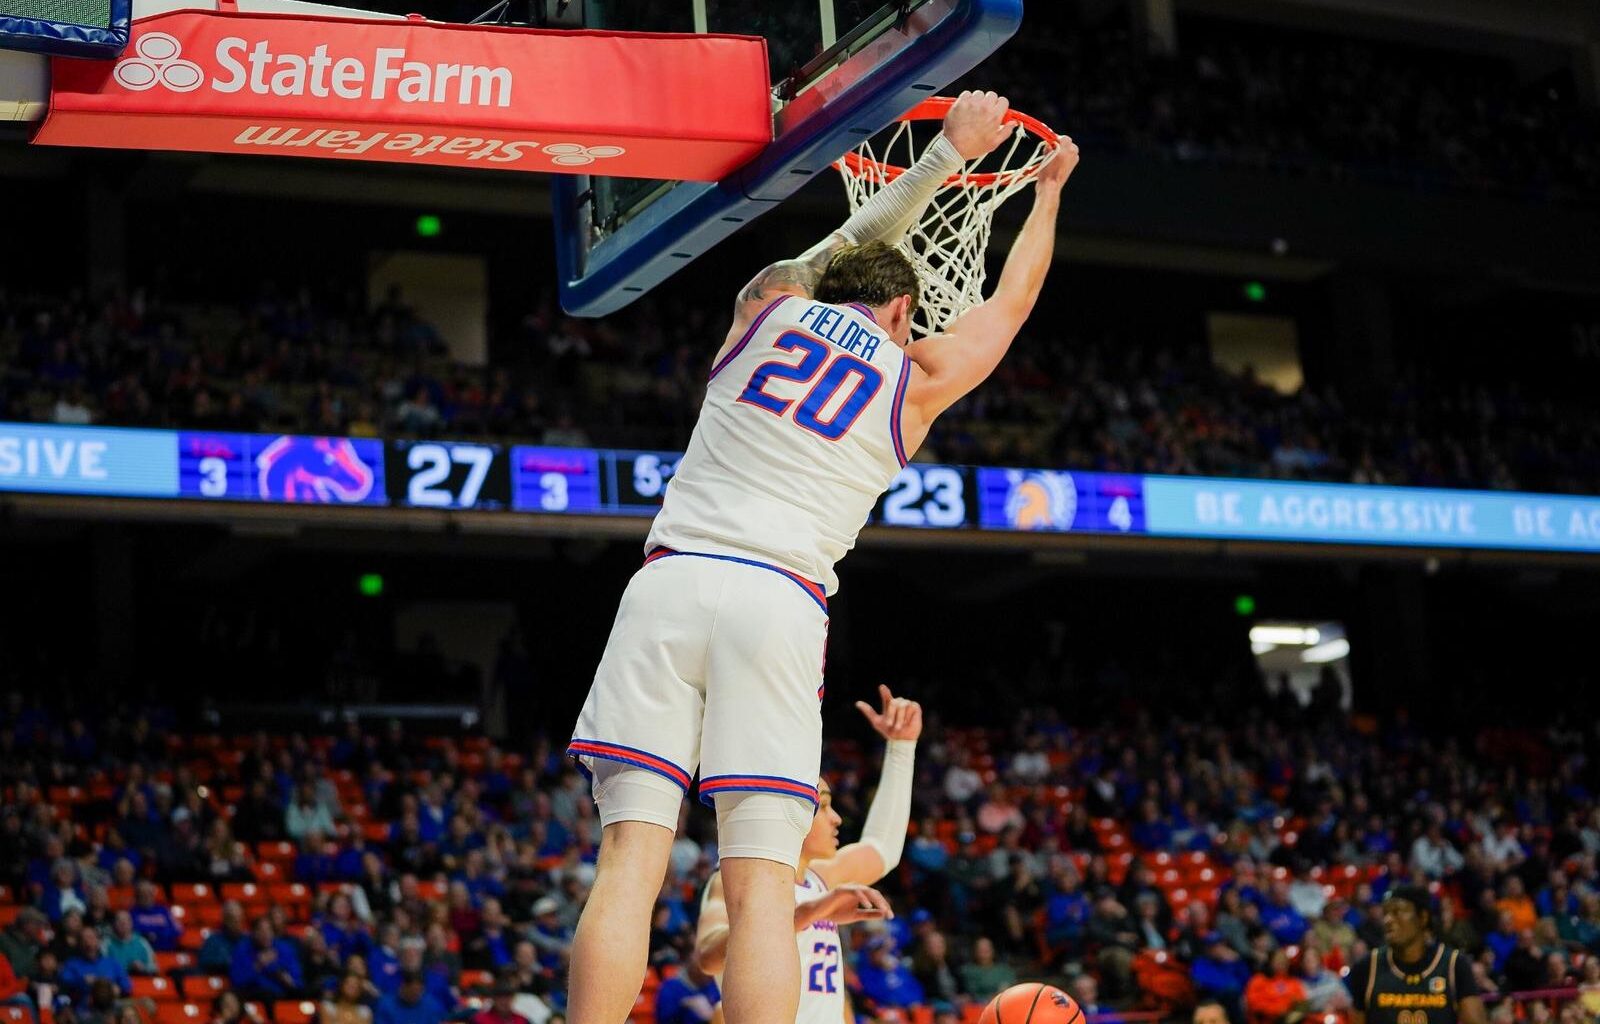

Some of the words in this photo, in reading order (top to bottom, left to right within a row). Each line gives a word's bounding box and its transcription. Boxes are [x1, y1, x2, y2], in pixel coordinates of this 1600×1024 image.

[798, 304, 881, 362] FIELDER
[736, 329, 884, 442] 20
[0, 437, 108, 479] SIVE
[199, 456, 227, 497] 3
[407, 444, 494, 507] 27
[540, 472, 568, 512] 3
[883, 466, 965, 528] 23
[1107, 495, 1132, 533] 4
[1195, 491, 1243, 525] BE
[1258, 495, 1477, 535] AGGRESSIVE
[1512, 505, 1555, 537] BE
[808, 942, 838, 994] 22
[1377, 992, 1448, 1008] SPARTANS
